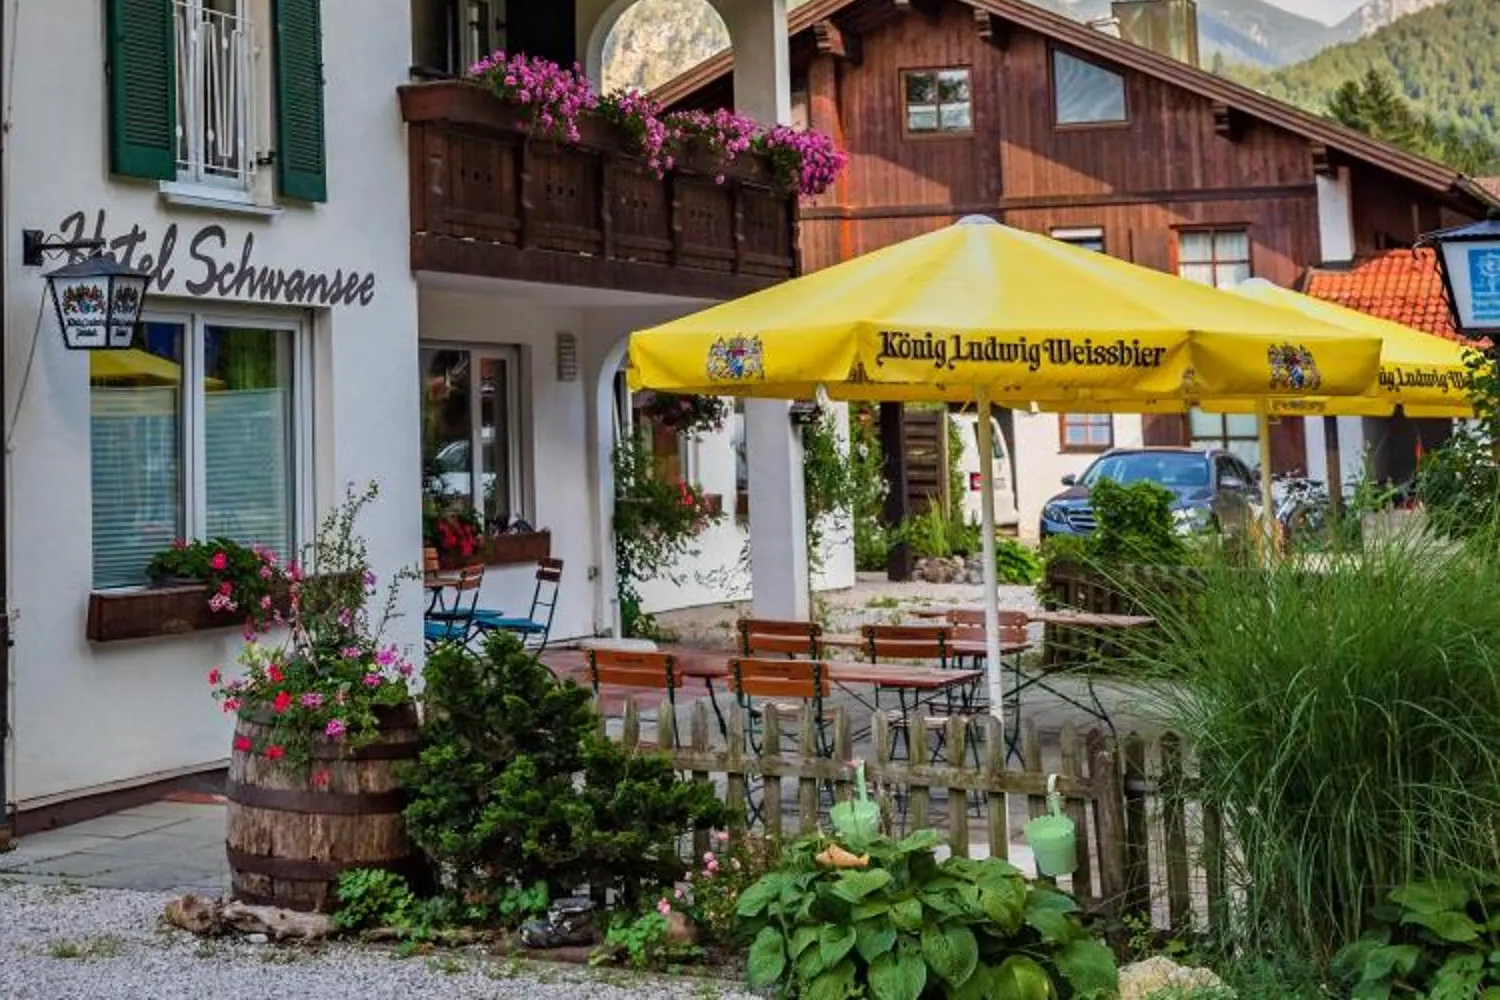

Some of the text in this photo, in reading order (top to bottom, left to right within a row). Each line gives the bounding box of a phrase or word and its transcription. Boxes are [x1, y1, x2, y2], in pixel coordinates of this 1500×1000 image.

[185, 224, 376, 306] Schwansee
[876, 331, 1166, 373] König Ludwig Weissbier
